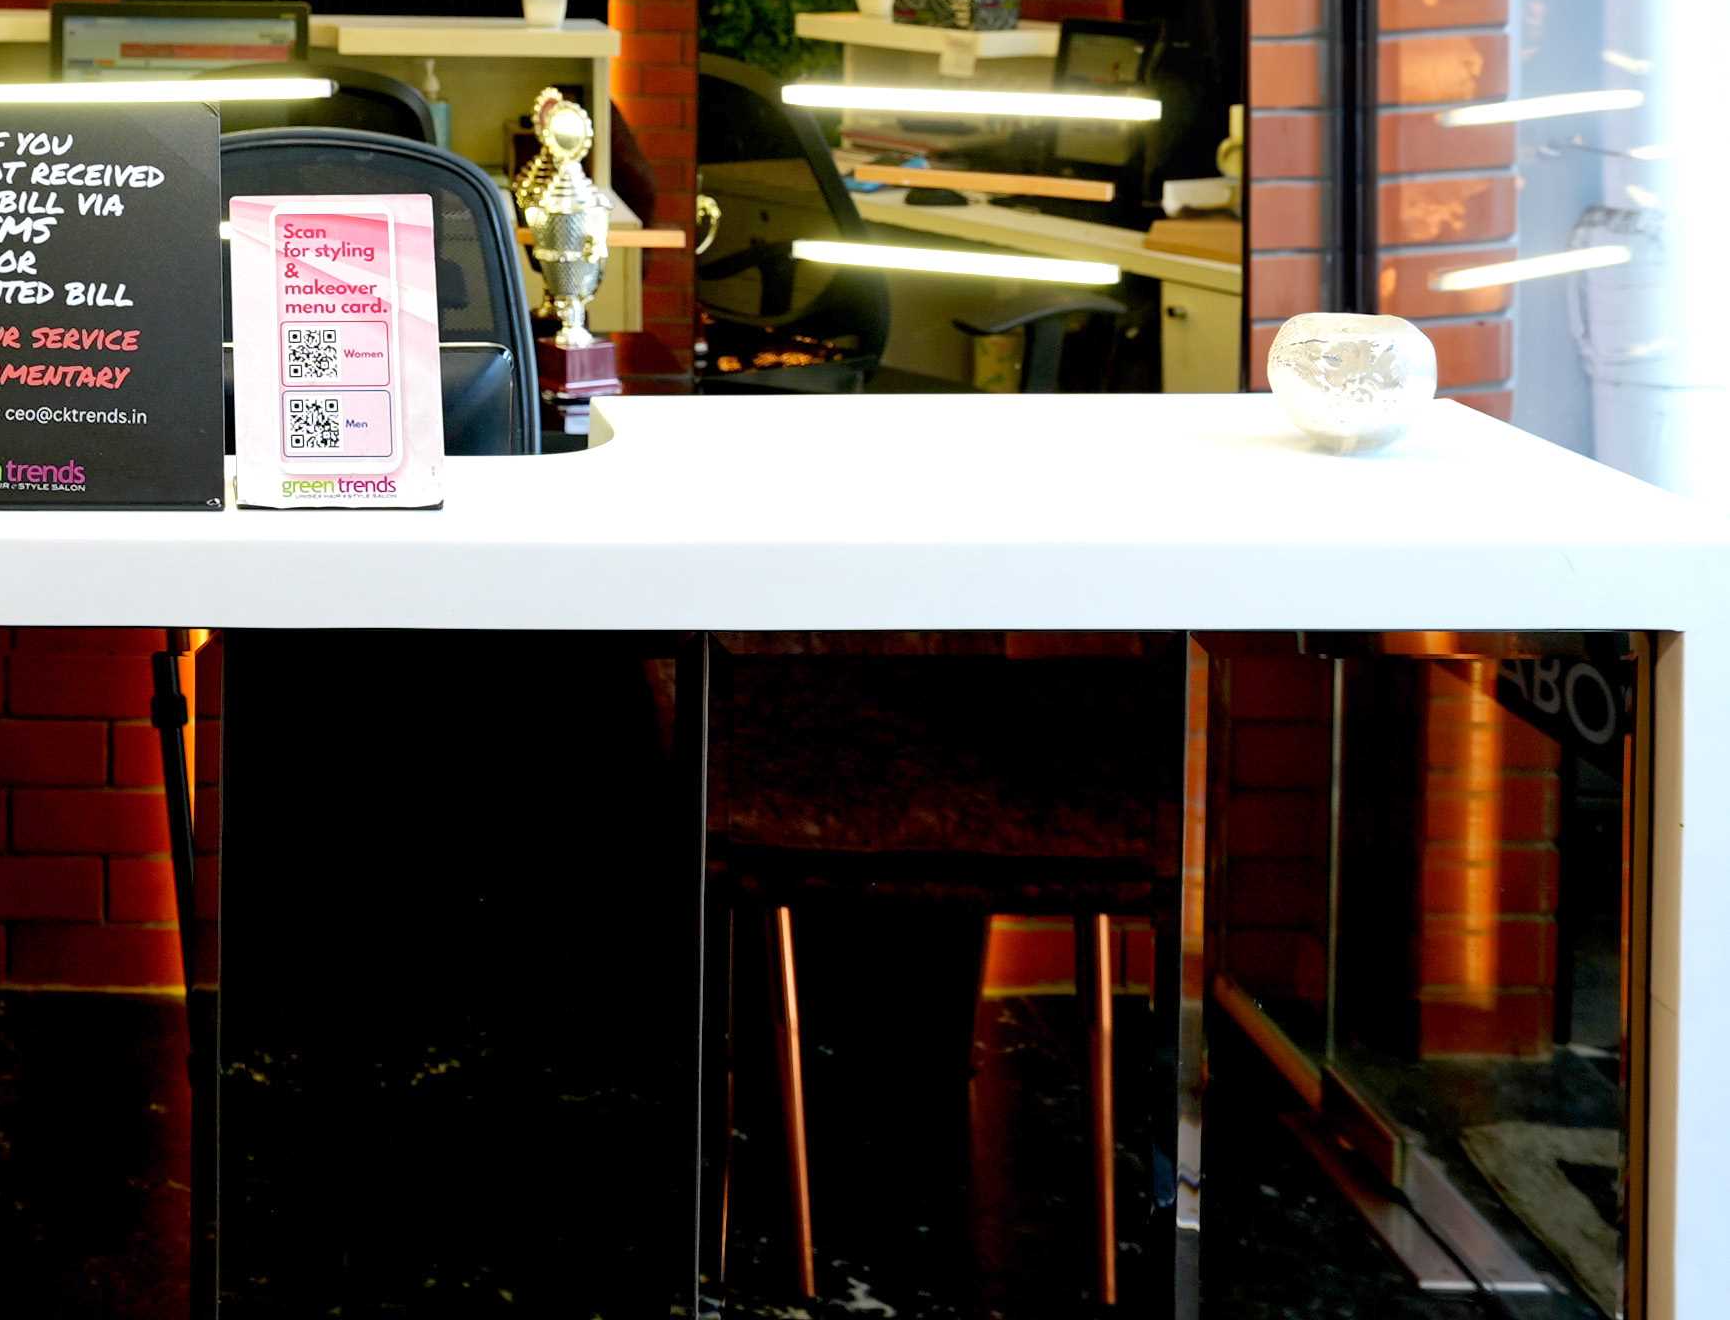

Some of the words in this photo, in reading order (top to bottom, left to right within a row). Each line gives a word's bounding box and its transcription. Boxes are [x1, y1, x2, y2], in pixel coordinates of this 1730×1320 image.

[17, 132, 73, 156] YOU
[30, 162, 166, 188] RECEIVED
[77, 192, 125, 217] VIA
[283, 223, 327, 239] Scan
[283, 241, 311, 258] for
[315, 241, 375, 262] styling
[284, 262, 300, 279] &
[64, 281, 134, 307] BILL
[284, 279, 378, 295] makeover
[285, 302, 336, 314] menu
[341, 297, 388, 314] card.
[31, 326, 141, 352] SERVICE
[344, 349, 384, 359] Women
[5, 406, 148, 425] ceo@cktrends.in
[345, 419, 369, 429] Men
[6, 459, 86, 484] trends
[19, 482, 50, 491] STYLE
[51, 483, 86, 492] SALON
[281, 480, 335, 498] green
[338, 475, 397, 493] trends
